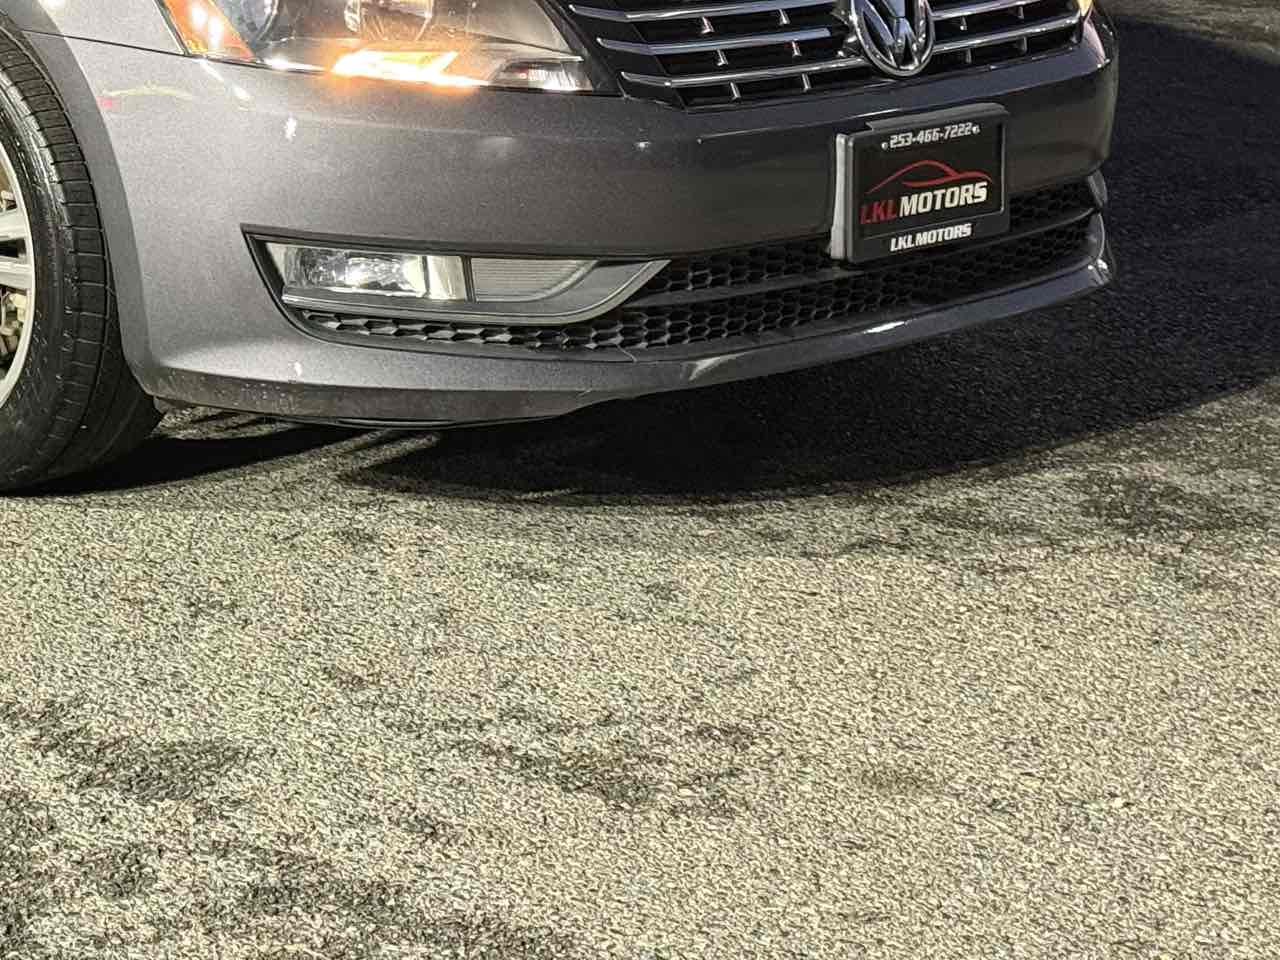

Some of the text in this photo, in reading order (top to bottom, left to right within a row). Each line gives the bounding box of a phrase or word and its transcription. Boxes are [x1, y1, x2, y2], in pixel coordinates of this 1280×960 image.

[889, 122, 973, 149] 253-466-7222
[859, 181, 988, 225] LKL MOTORS
[915, 223, 973, 246] MOTORS
